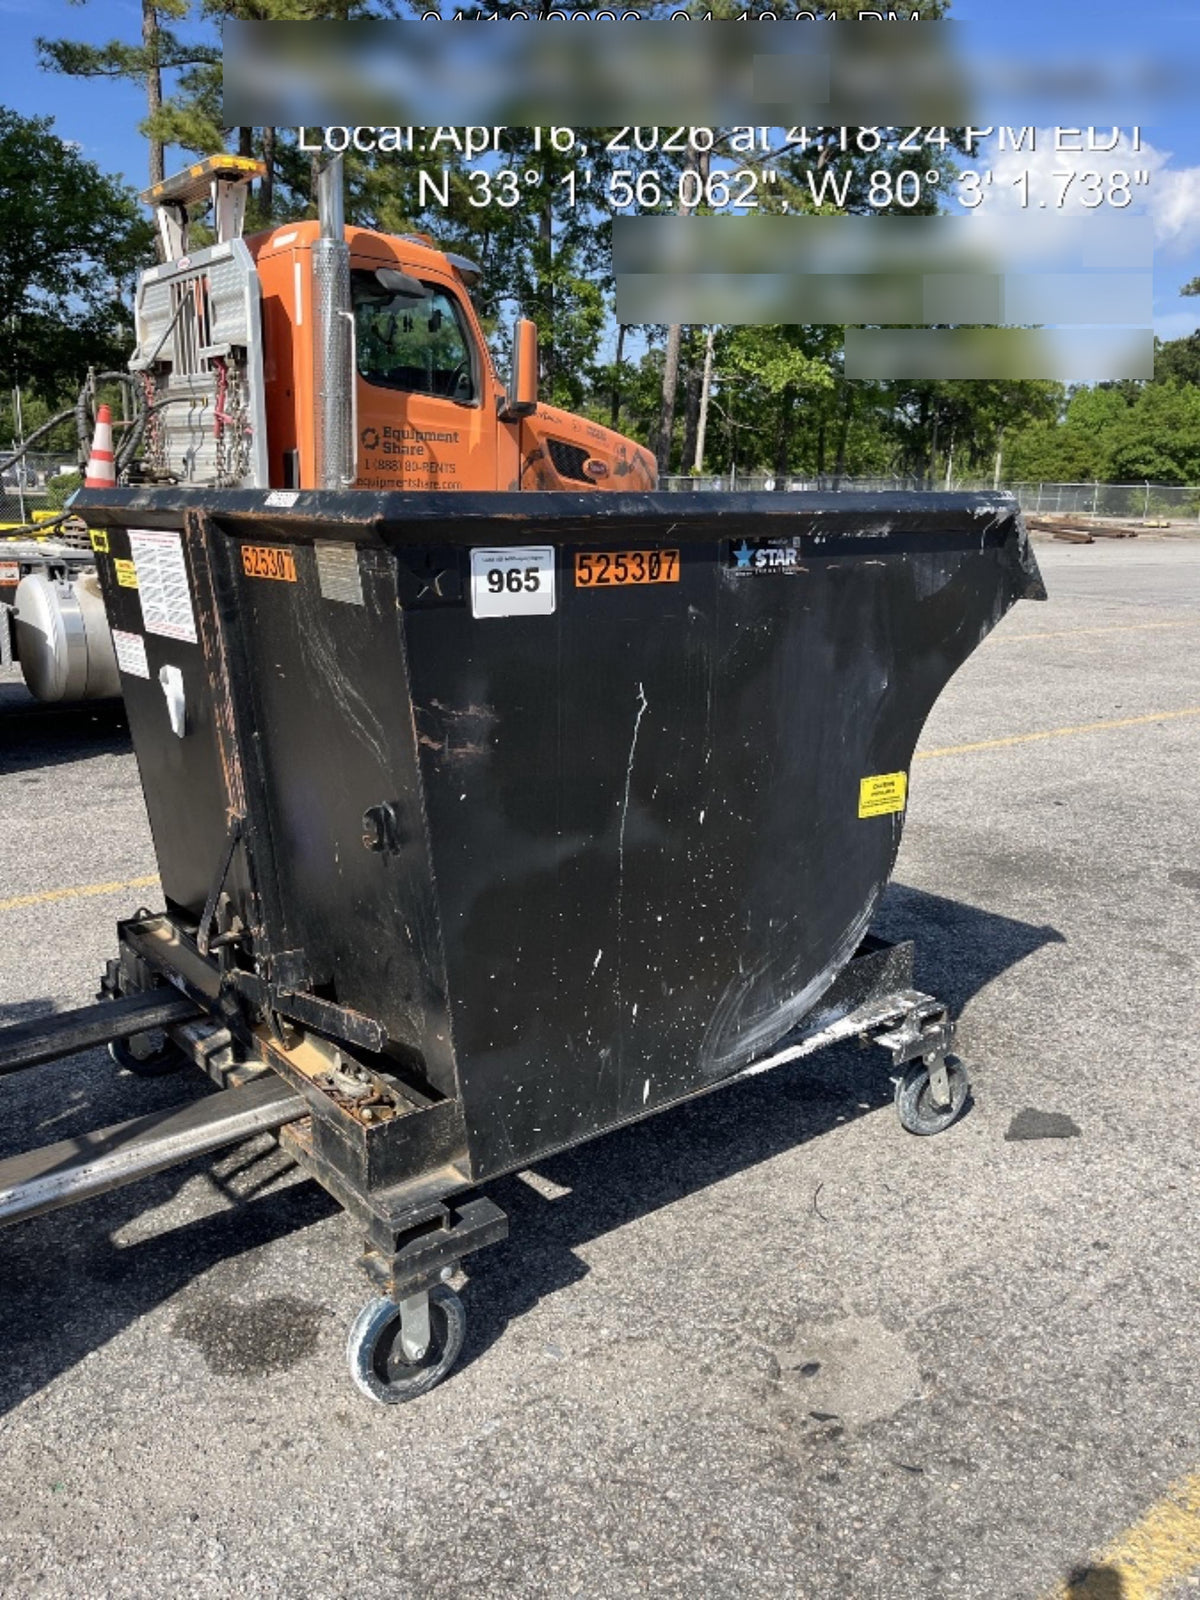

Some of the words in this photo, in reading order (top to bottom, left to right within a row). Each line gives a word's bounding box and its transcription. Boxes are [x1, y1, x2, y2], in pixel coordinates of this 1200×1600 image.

[383, 426, 460, 443] Equipment
[383, 442, 425, 456] Share
[242, 546, 295, 580] 525307
[577, 551, 678, 585] 525307
[755, 547, 798, 567] STAR
[487, 566, 541, 593] 965
